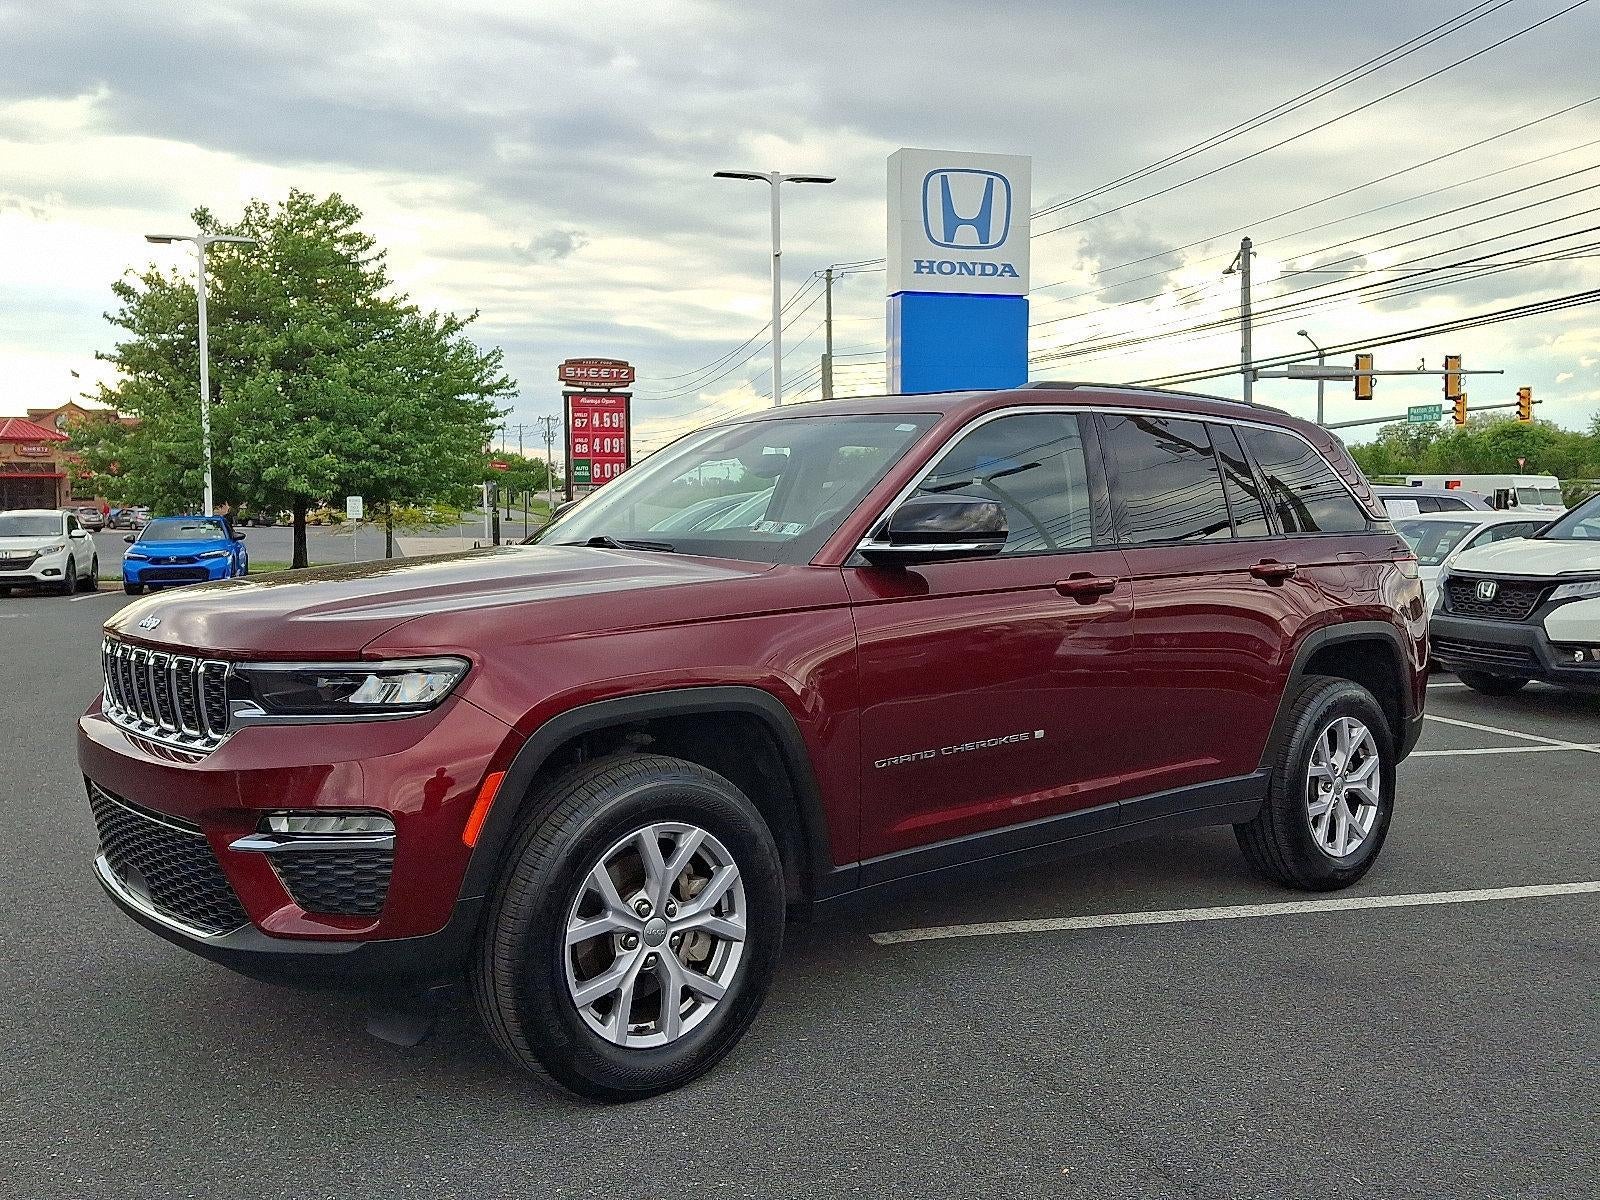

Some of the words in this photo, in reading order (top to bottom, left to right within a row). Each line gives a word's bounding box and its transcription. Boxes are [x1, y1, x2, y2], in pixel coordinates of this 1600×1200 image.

[913, 259, 1020, 278] HONDA
[565, 367, 630, 379] SHEETZ
[580, 397, 601, 405] Always
[601, 397, 617, 405] Open
[574, 418, 588, 428] 87
[574, 443, 589, 453] 88
[874, 749, 936, 769] GRAND
[941, 732, 1030, 756] CHEROKEE
